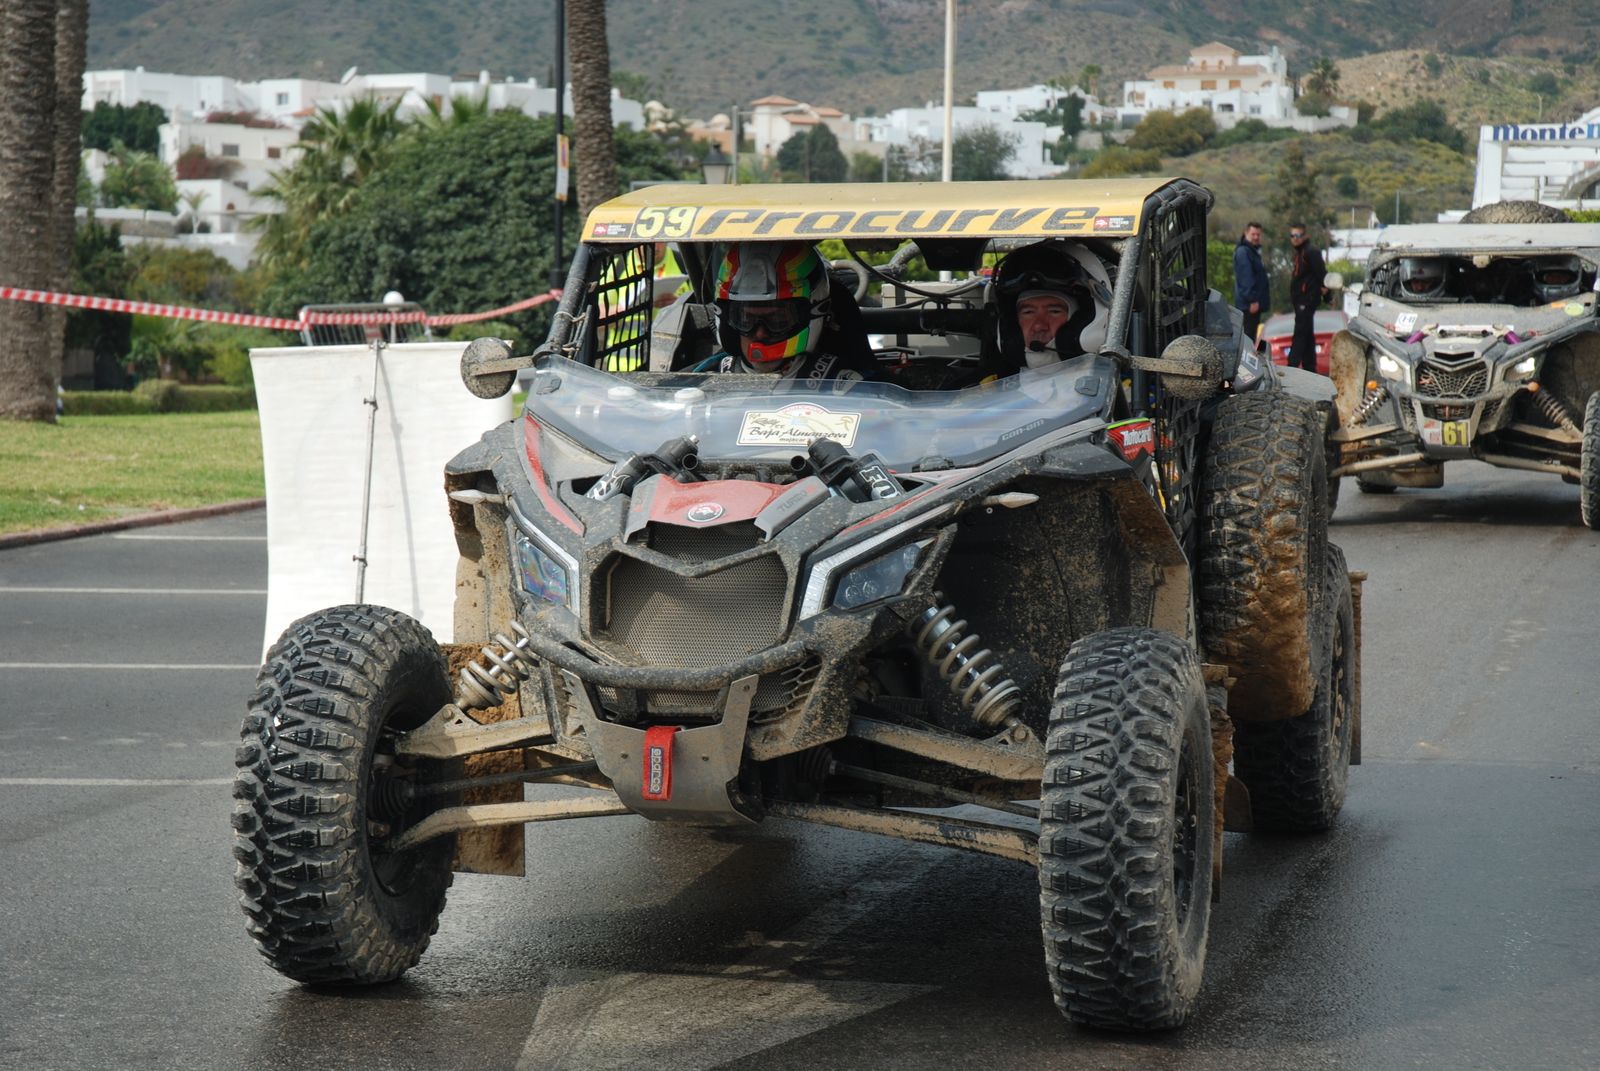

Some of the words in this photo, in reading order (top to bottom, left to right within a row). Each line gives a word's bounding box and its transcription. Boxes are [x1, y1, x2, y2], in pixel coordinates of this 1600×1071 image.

[636, 206, 698, 238] 59
[748, 426, 780, 439] Baja
[1443, 421, 1468, 446] 61
[858, 465, 902, 500] FO
[650, 747, 663, 794] sparco
